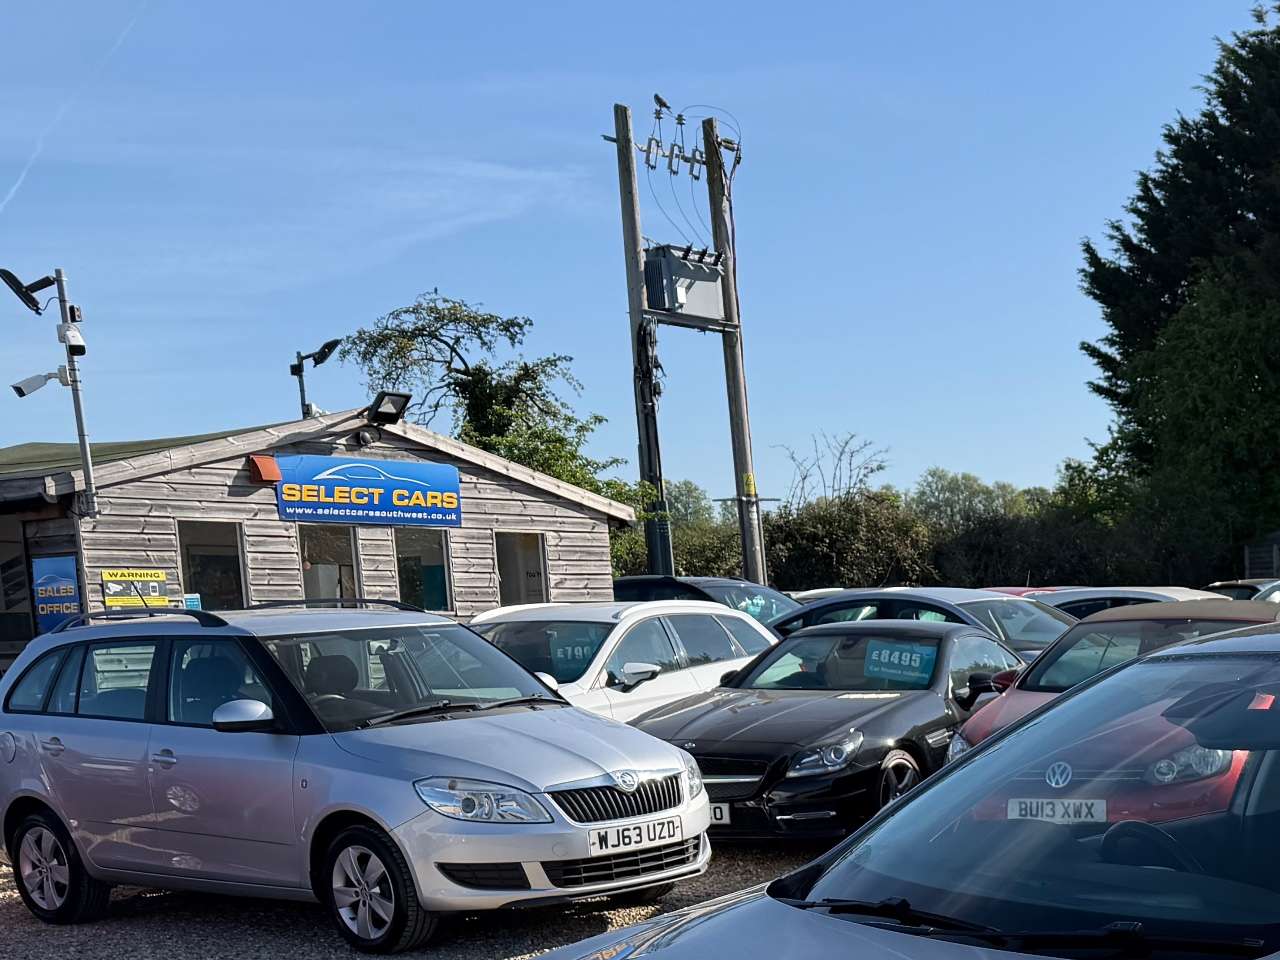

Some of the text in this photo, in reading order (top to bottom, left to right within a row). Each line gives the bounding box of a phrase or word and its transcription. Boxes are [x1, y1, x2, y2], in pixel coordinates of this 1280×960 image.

[282, 484, 458, 509] SELECT CARS
[38, 585, 75, 598] SALES
[38, 602, 80, 614] OFFICE
[872, 649, 921, 668] £8495
[1018, 801, 1095, 819] BU13 XWX
[597, 820, 676, 851] WJ63 UZD
